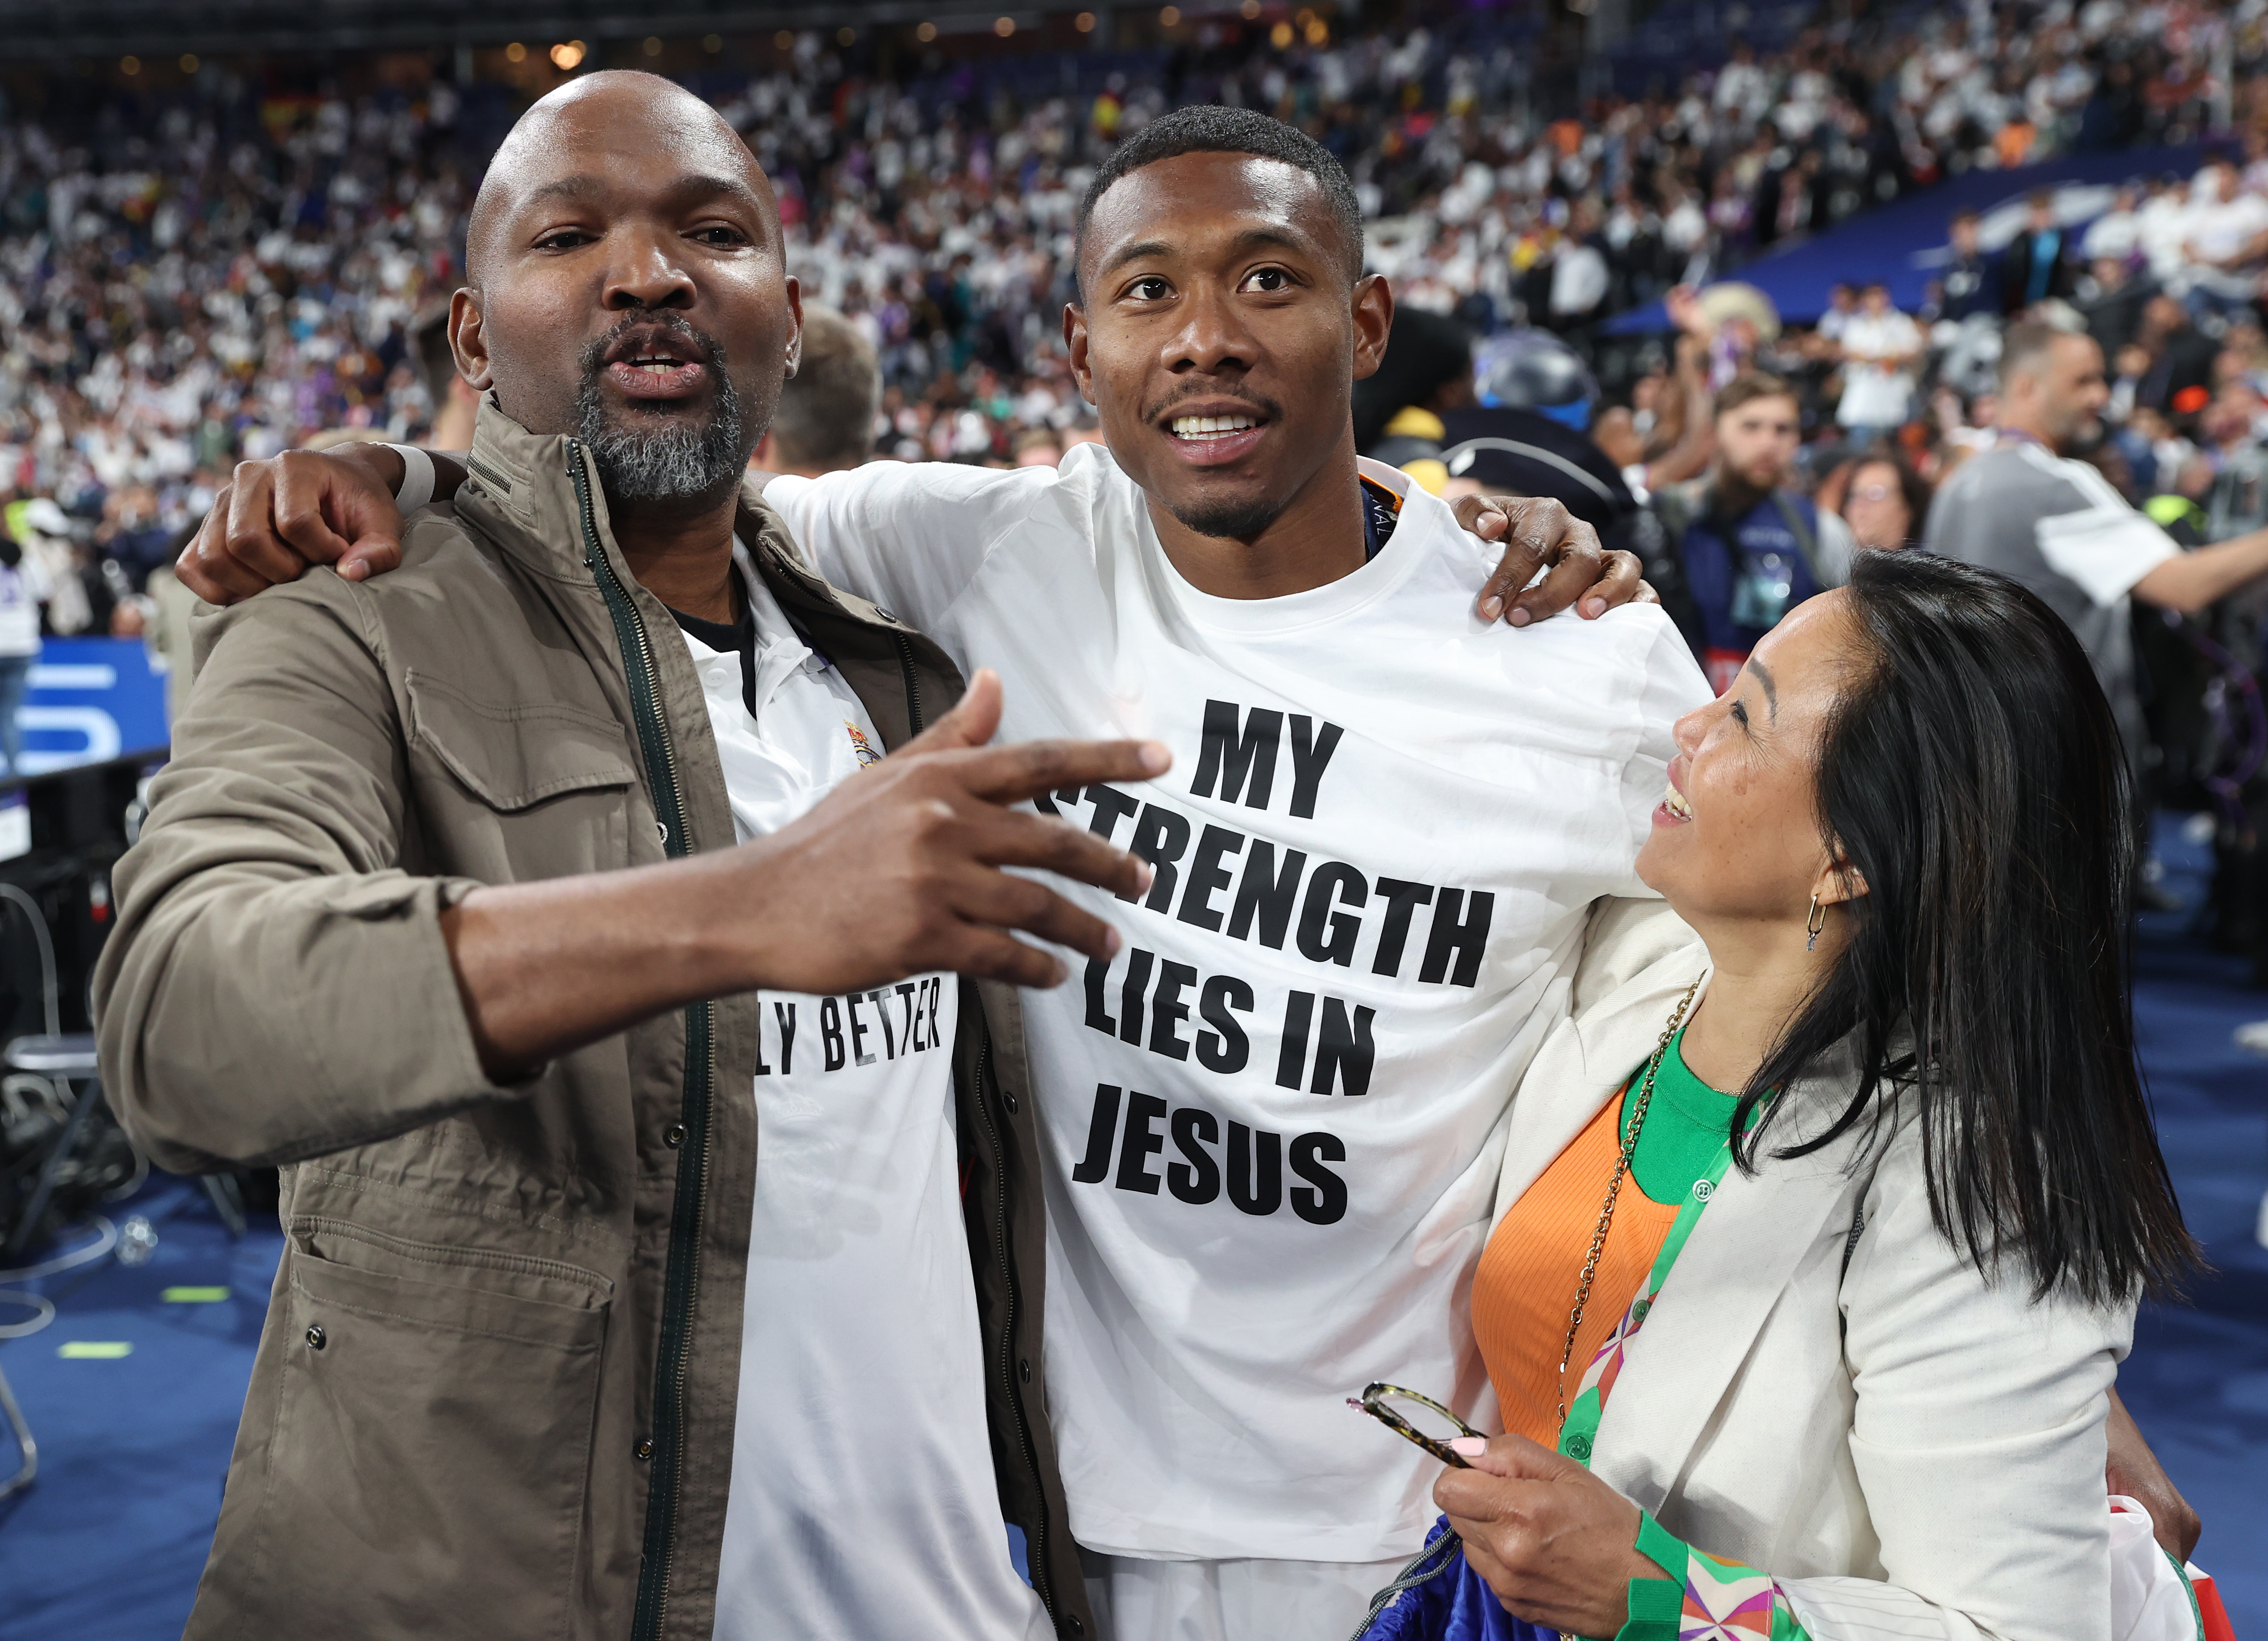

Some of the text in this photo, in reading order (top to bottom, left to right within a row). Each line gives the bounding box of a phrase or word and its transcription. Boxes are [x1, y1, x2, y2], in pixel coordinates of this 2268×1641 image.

[1189, 699, 1344, 820] MY
[820, 976, 940, 1072] BETTER
[1084, 947, 1376, 1096] LIES IN
[1071, 1083, 1348, 1226] JESUS
